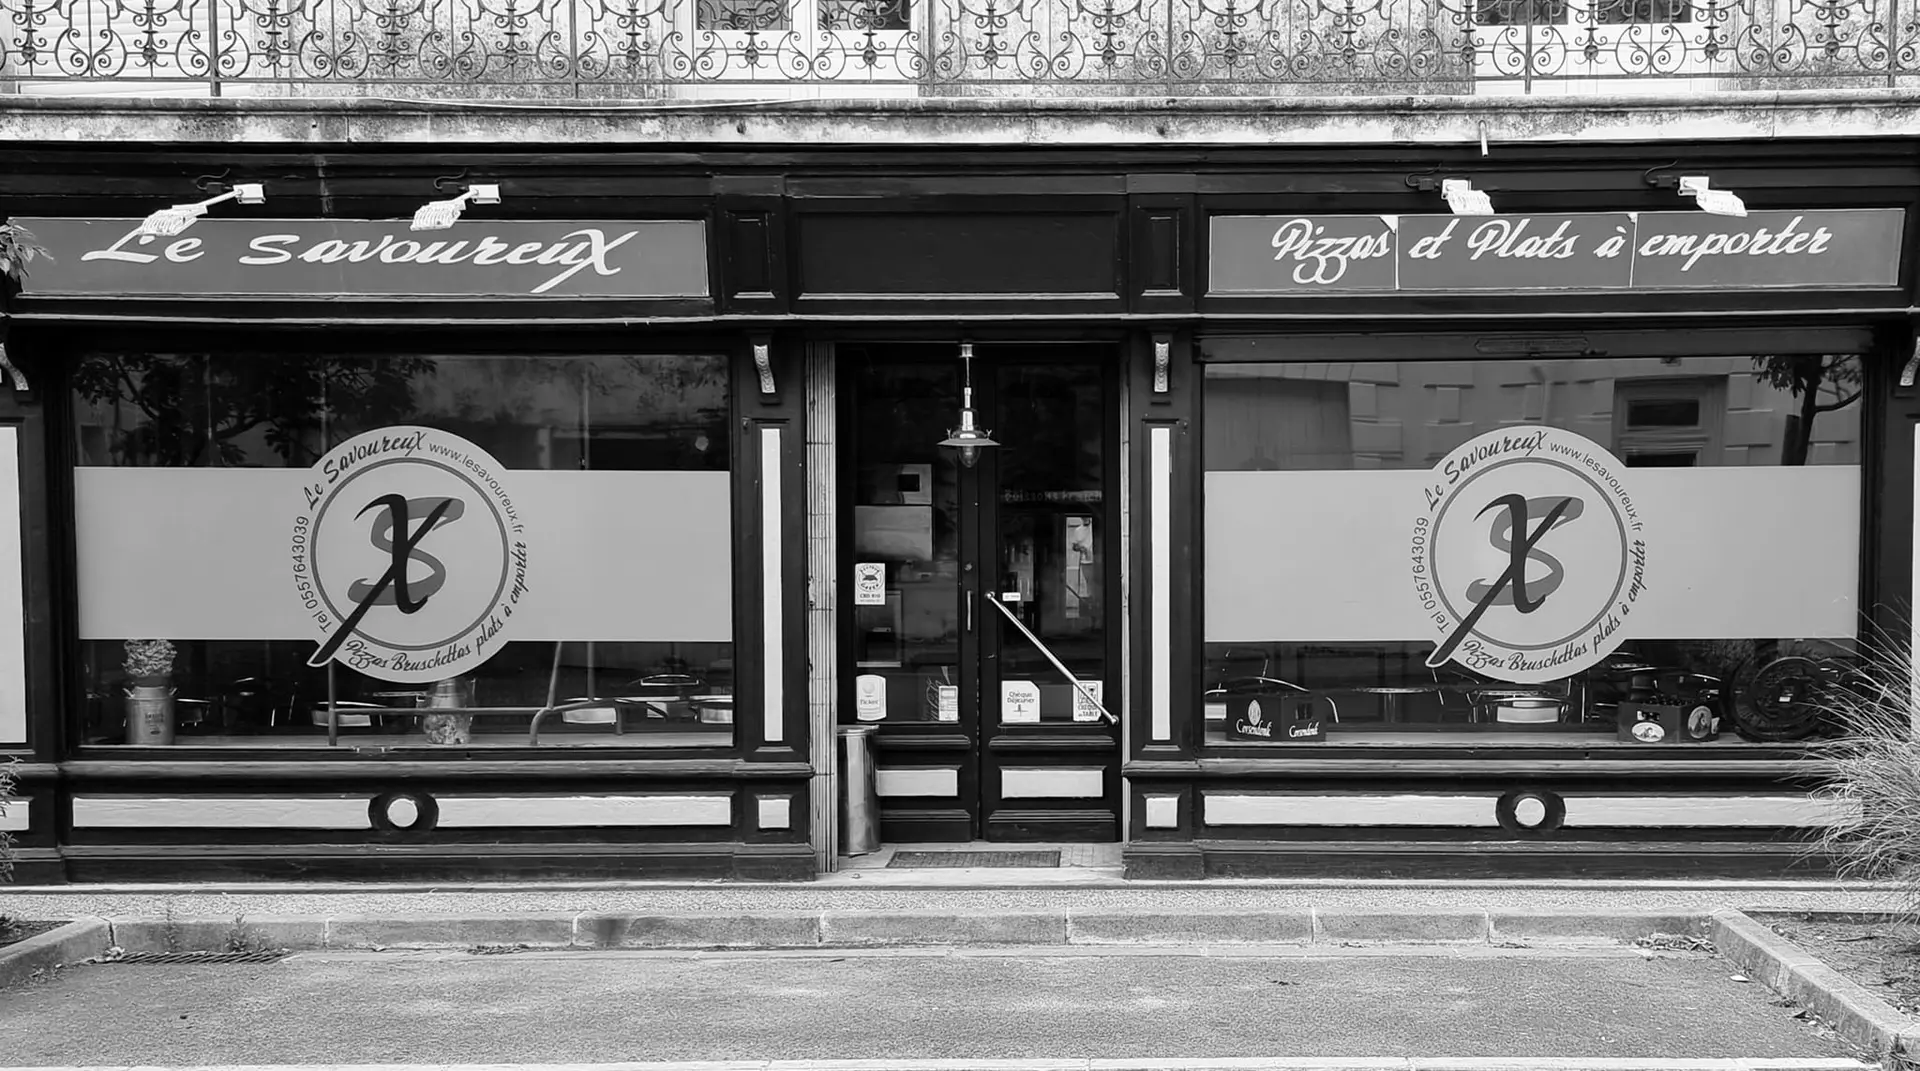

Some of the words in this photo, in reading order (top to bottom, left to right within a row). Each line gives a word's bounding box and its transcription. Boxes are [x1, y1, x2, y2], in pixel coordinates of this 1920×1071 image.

[81, 227, 204, 263] Le
[1271, 219, 1390, 285] Pizzas
[1409, 218, 1460, 260] et
[1468, 219, 1579, 261] Plats
[1593, 225, 1627, 258] à
[1639, 215, 1833, 271] emporter
[305, 482, 324, 511] Le
[429, 441, 525, 534] www.lesavoureux.fr
[1424, 483, 1444, 512] Le
[1550, 441, 1644, 533] www.lesavoureux.fr
[292, 516, 318, 609] 0557643039
[1411, 517, 1436, 609] 0557643039
[312, 610, 333, 633] Tel
[345, 639, 388, 669] Pizzas
[391, 645, 471, 672] Bruschettas
[475, 616, 504, 656] plats
[501, 602, 513, 618] à
[510, 541, 529, 605] emporter
[1431, 610, 1450, 633] Tel
[1462, 639, 1505, 670] Pizzas
[1508, 644, 1588, 671] Bruschettas
[1592, 614, 1621, 654] plats
[1618, 601, 1630, 616] à
[1628, 539, 1647, 602] emporter
